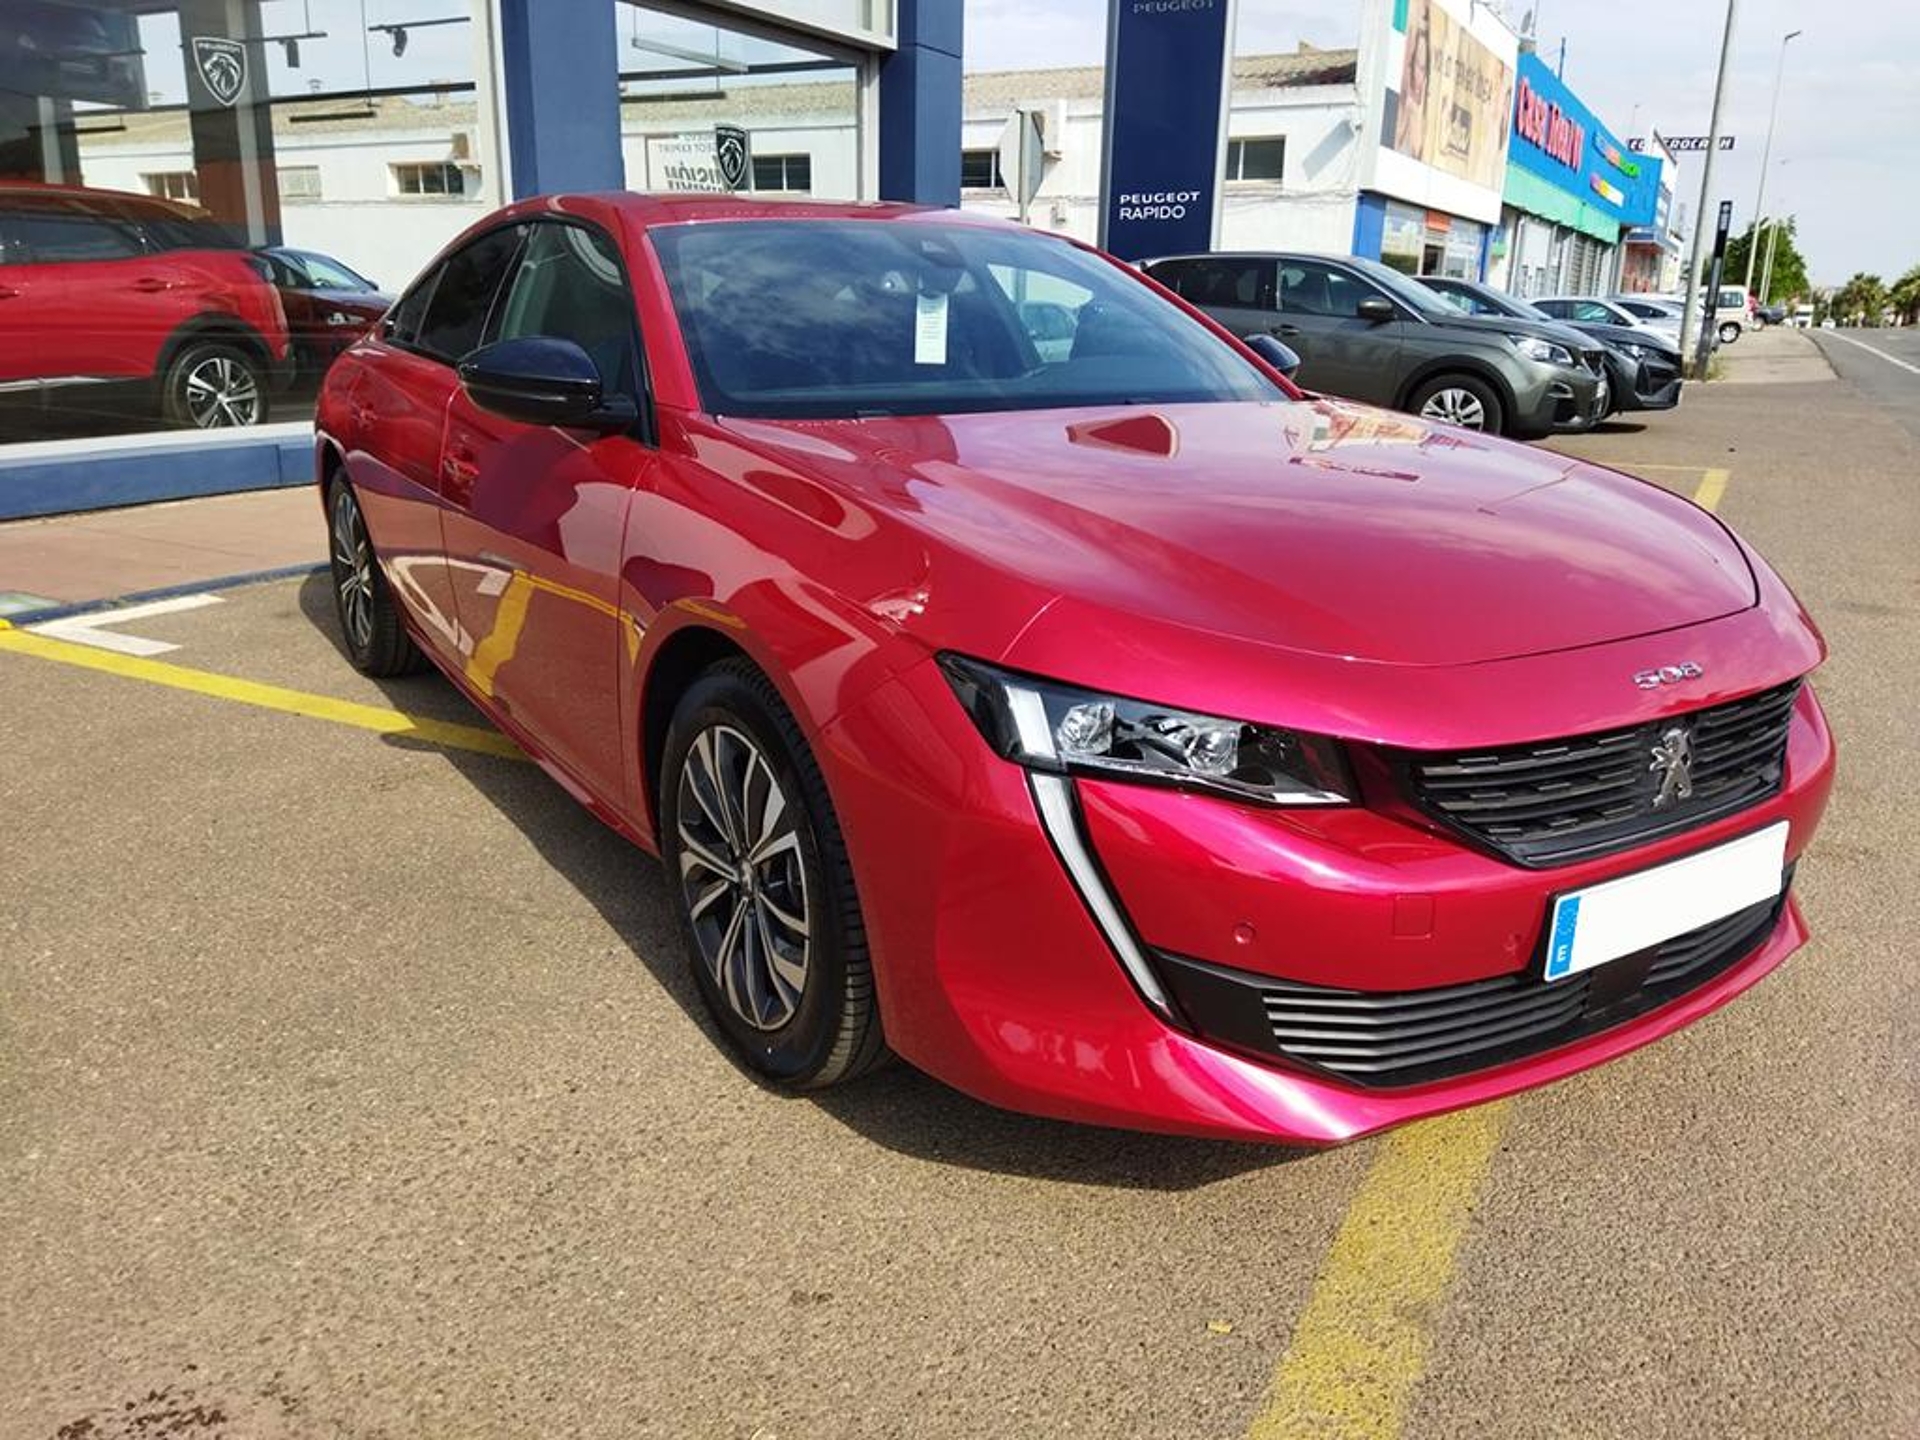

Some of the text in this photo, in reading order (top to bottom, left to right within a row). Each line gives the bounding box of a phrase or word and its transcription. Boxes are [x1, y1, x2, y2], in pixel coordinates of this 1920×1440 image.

[1120, 191, 1201, 205] PEUGEOT
[1120, 205, 1186, 220] RAPIDO
[1633, 661, 1704, 691] 508
[1557, 944, 1569, 963] E
